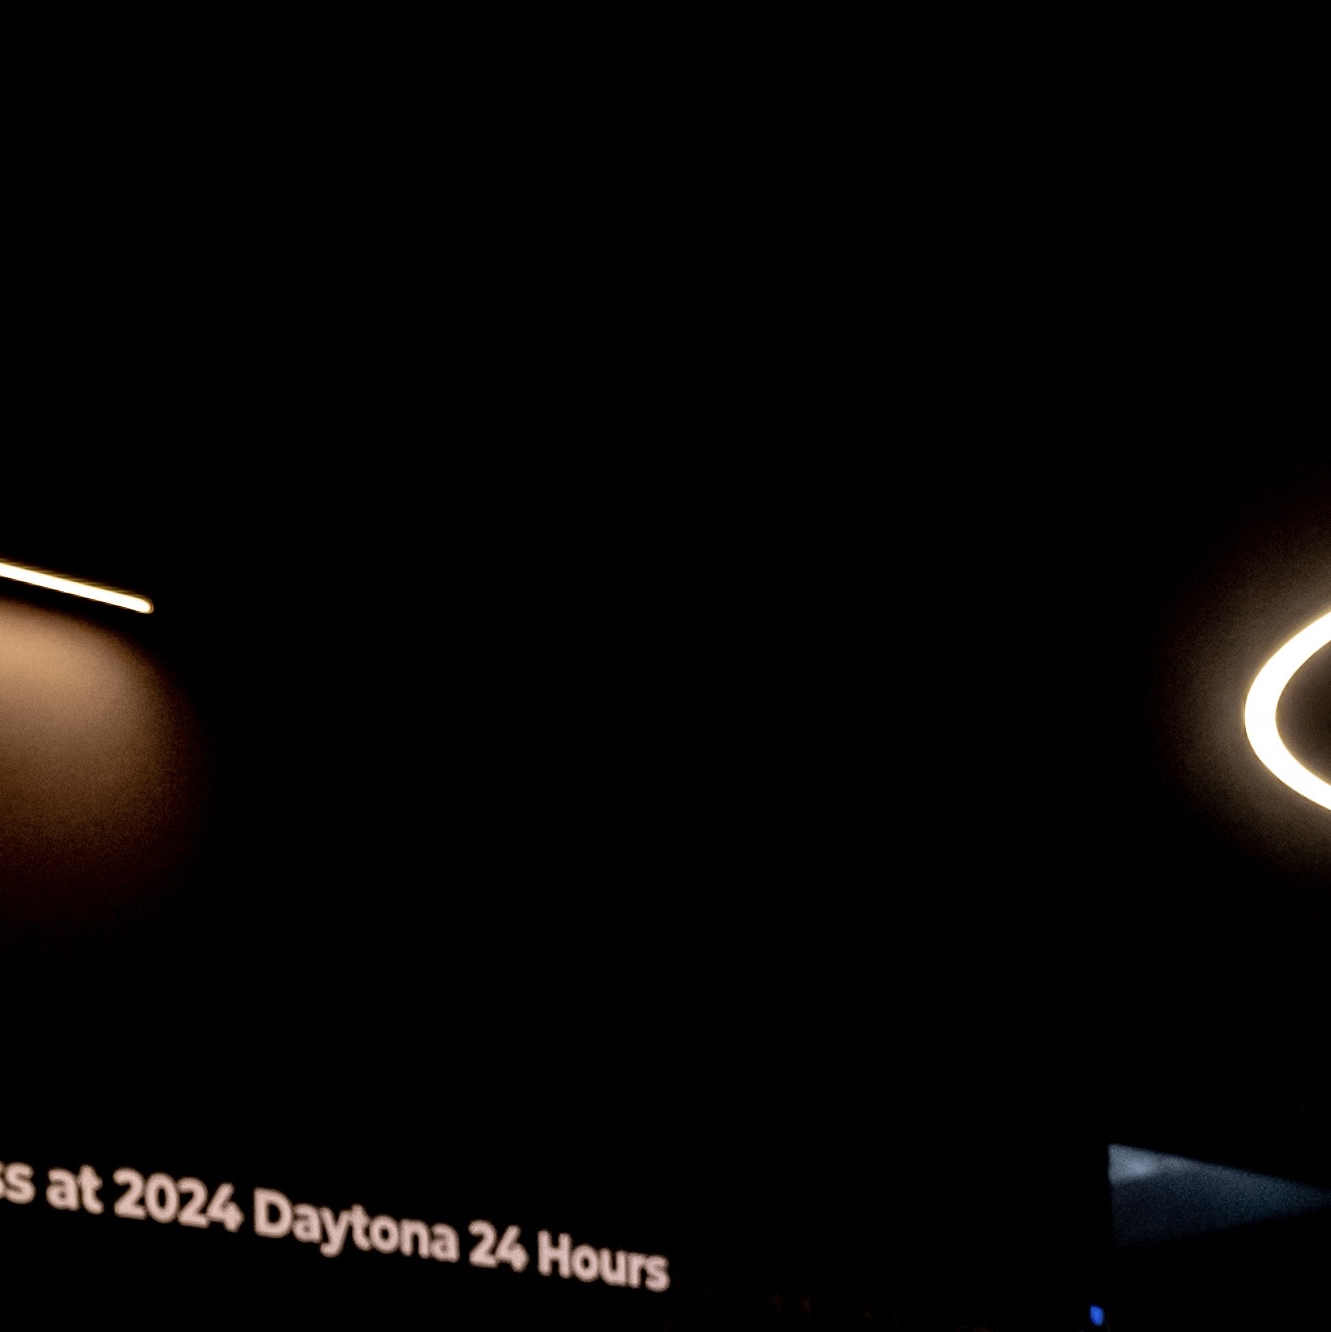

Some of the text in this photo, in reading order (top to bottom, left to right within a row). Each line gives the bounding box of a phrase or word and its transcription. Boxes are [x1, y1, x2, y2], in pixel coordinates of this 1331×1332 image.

[47, 1167, 102, 1213] at
[114, 1170, 242, 1230] 2024
[255, 1189, 459, 1261] Daytona
[470, 1221, 527, 1270] 24
[539, 1231, 669, 1290] Hours
